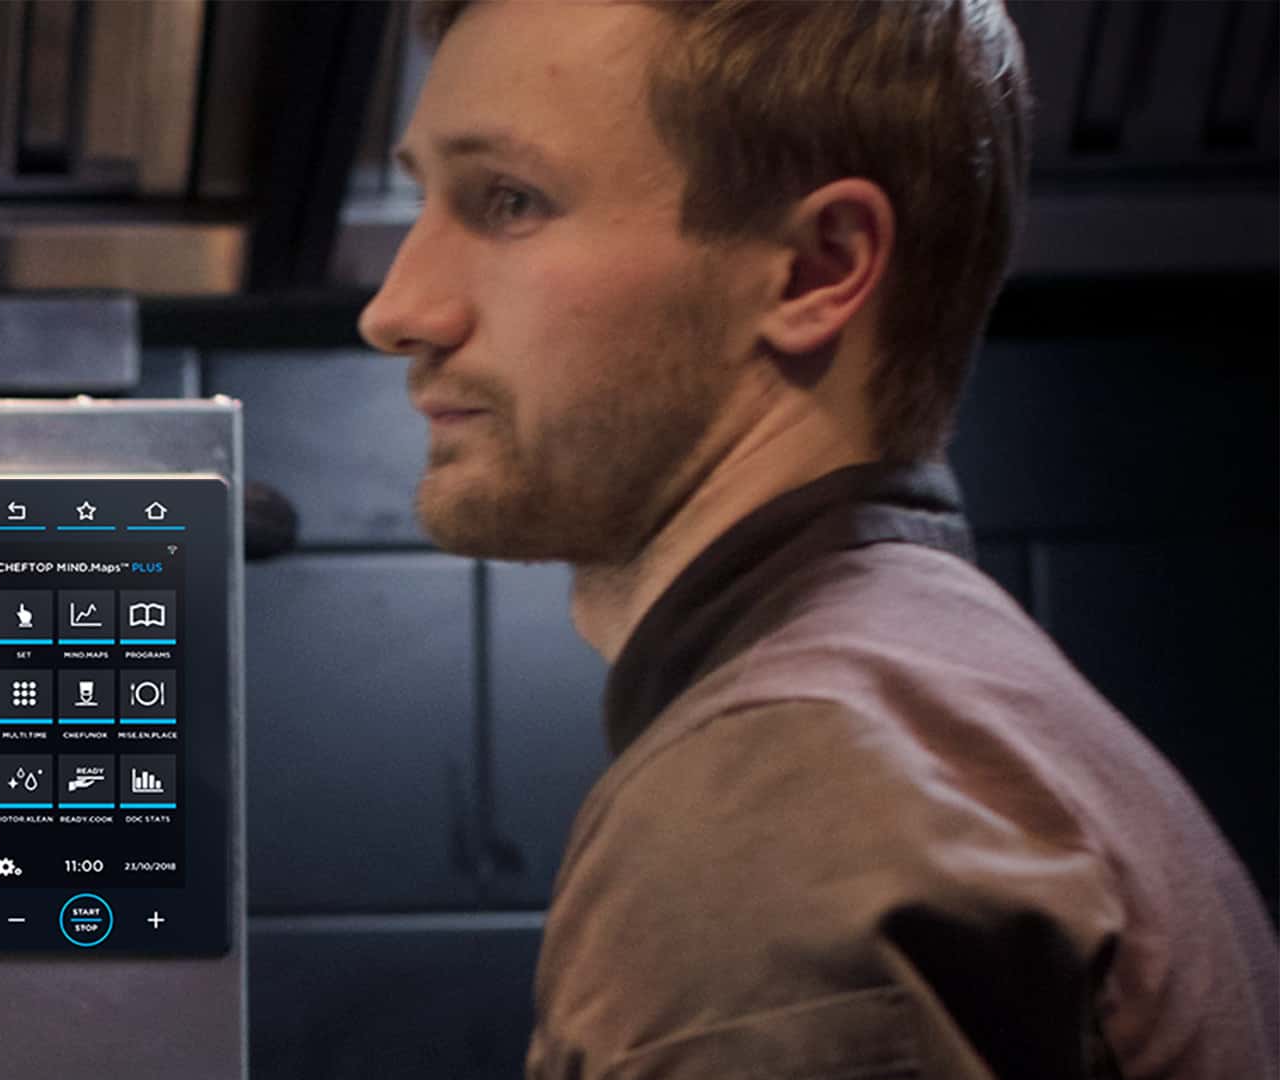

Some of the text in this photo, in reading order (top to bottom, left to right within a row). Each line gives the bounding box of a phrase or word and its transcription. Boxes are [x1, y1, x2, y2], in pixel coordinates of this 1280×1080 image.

[131, 562, 163, 573] PLUS
[16, 651, 32, 659] SET
[125, 651, 171, 659] PROGRAMS
[76, 767, 104, 775] READY
[145, 815, 171, 823] STATS
[64, 859, 104, 873] 11:00
[72, 908, 100, 917] START
[74, 924, 98, 932] STOP
